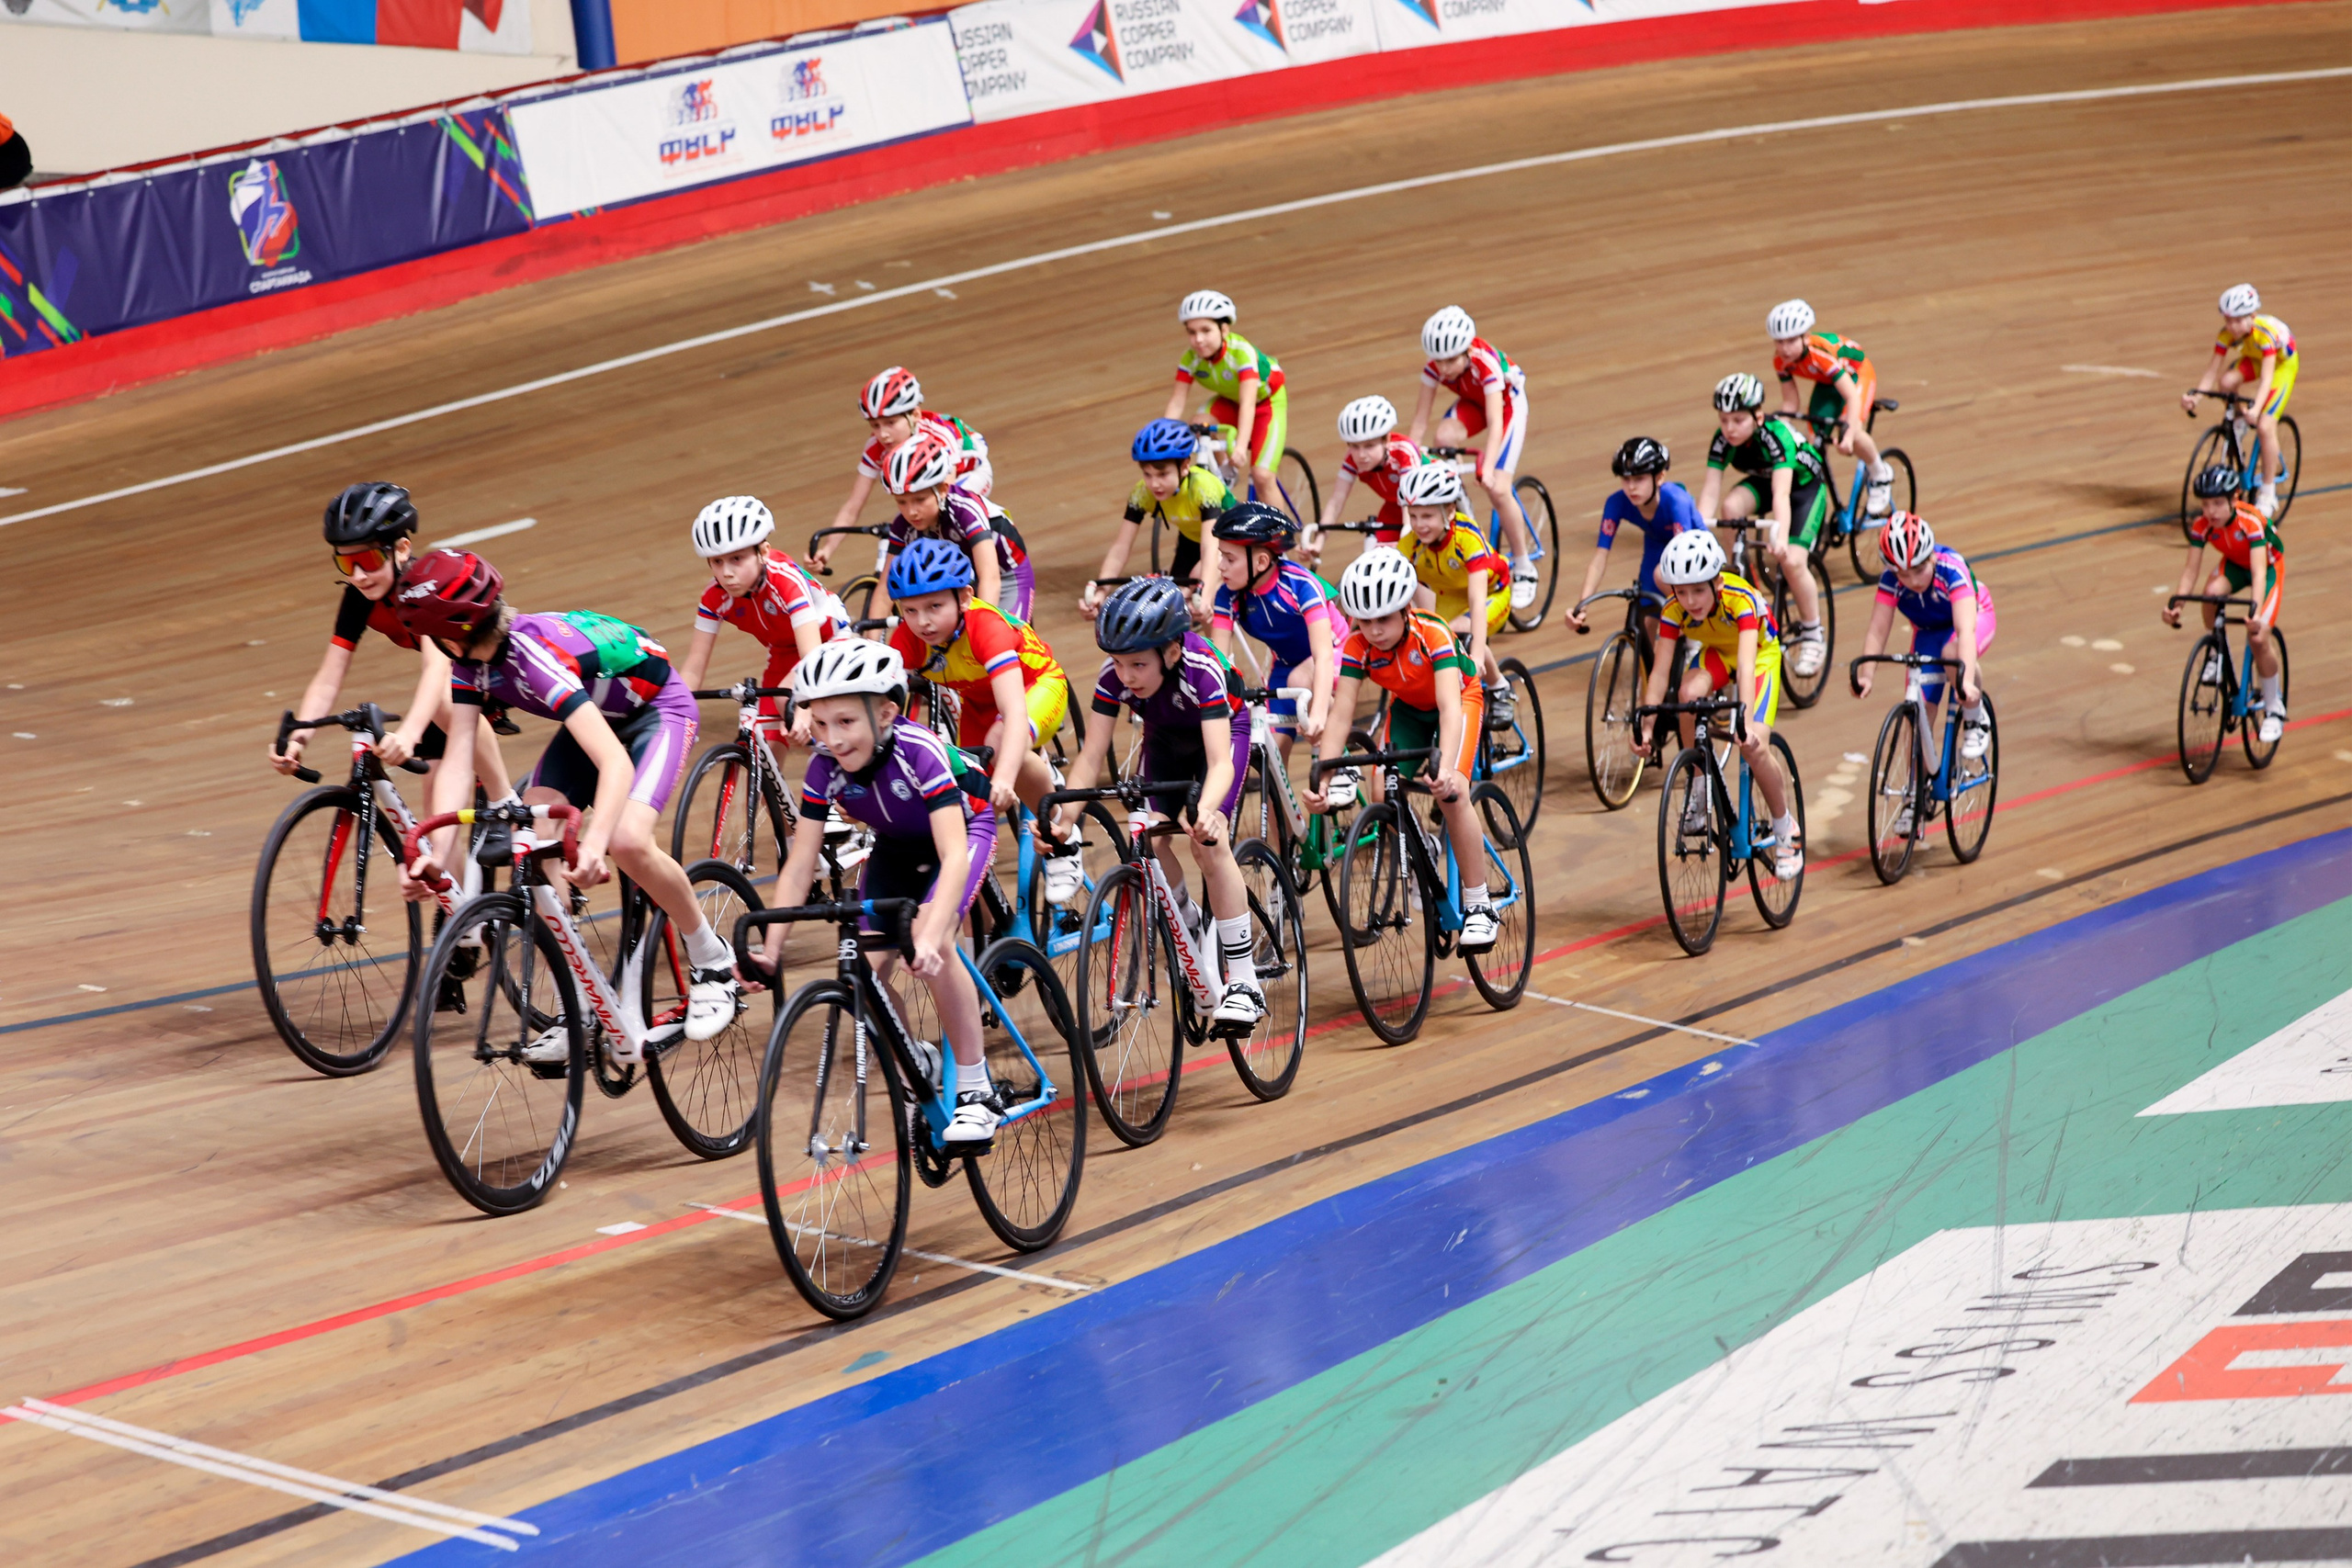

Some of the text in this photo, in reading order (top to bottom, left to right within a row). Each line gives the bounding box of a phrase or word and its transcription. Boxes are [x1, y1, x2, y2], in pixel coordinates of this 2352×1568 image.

[1114, 0, 1180, 21] RUSSIAN
[956, 21, 1013, 51] USSIAN
[1119, 19, 1177, 45] COPPER
[1288, 15, 1353, 41] COMPANY
[960, 49, 1009, 74] OPPER
[1125, 41, 1194, 70] COMPANY
[966, 71, 1026, 99] OMPANY
[1156, 886, 1205, 993] PINARELLO
[545, 915, 624, 1040] PINARELLO
[1584, 1410, 1958, 1562] WATC
